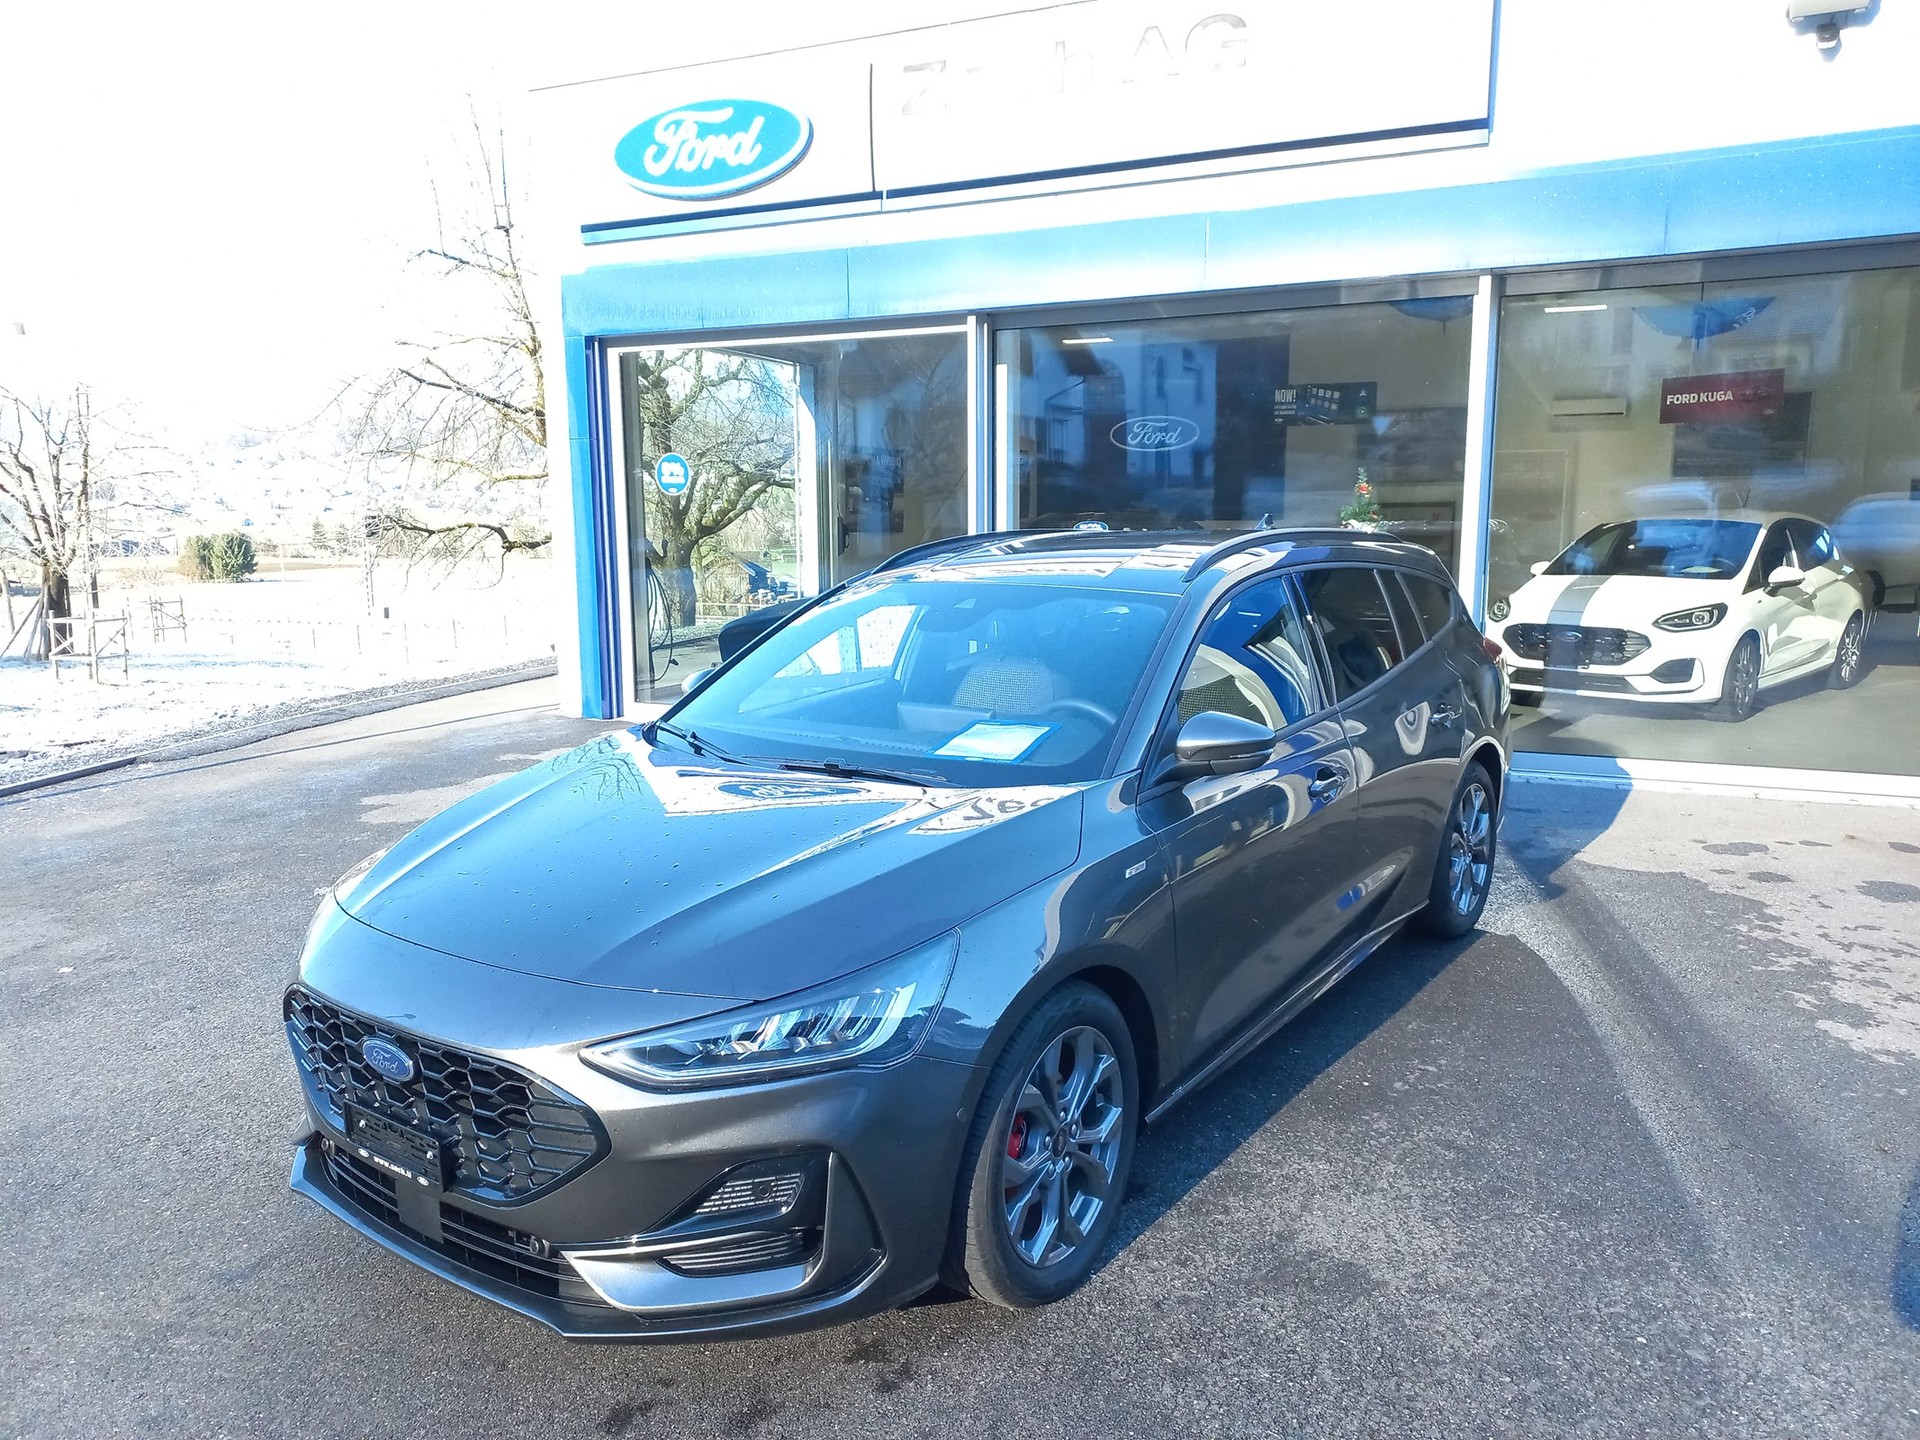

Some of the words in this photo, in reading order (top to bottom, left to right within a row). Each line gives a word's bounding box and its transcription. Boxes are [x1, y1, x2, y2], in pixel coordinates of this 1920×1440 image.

[1122, 13, 1248, 84] AG
[643, 106, 763, 177] Ford
[1275, 389, 1296, 403] NOW!
[1666, 393, 1699, 405] FORD
[1699, 390, 1734, 403] KUGA
[1127, 420, 1181, 446] Ford
[370, 1048, 399, 1075] Ford
